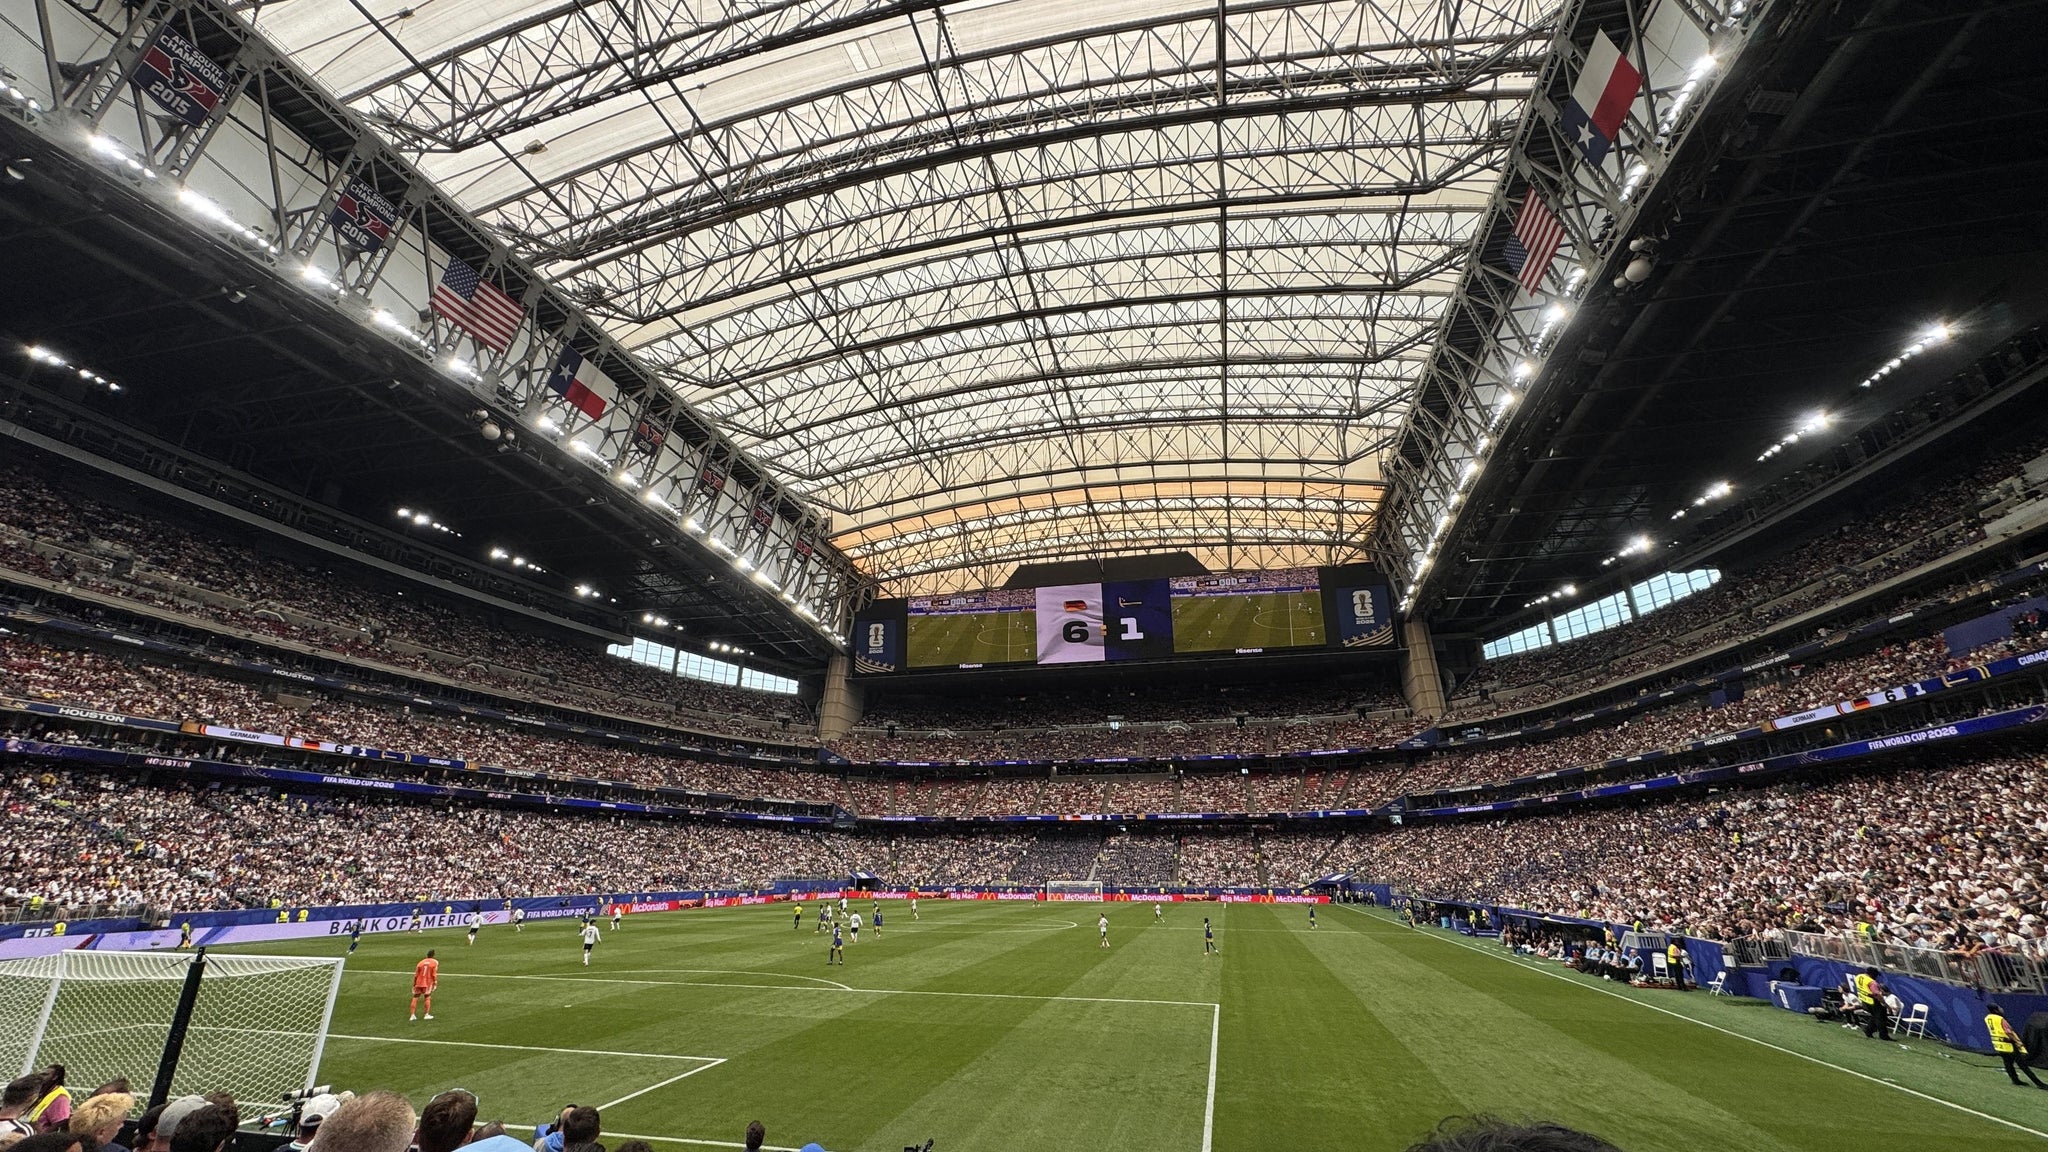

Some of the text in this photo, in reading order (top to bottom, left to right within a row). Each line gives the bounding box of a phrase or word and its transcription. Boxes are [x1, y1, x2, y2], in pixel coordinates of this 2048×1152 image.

[160, 34, 225, 89] CHAMPIONS
[172, 35, 223, 77] AFC SOUTH
[149, 81, 191, 115] 2015
[350, 184, 396, 222] CHAMPIONS
[358, 183, 395, 212] AFC SOUTH
[341, 221, 370, 246] 2016
[1062, 617, 1144, 643] 6 1
[272, 669, 315, 682] HOUSTON
[1885, 682, 1926, 702] 6 1
[58, 708, 126, 722] HOUSTON
[1792, 712, 1816, 723] GERMANY
[230, 730, 261, 740] GERMANY
[1704, 734, 1737, 746] HOUSTON
[1868, 726, 1958, 750] FIFA WORLD CUP 2026
[335, 744, 368, 756] 6 1
[145, 758, 192, 768] HOUSTON
[338, 778, 361, 786] WORLD
[705, 899, 713, 907] Big
[1220, 894, 1232, 902] Big
[1276, 894, 1318, 904] McDelivery
[631, 902, 669, 912] McDonald's
[526, 910, 540, 919] FIFA
[541, 909, 562, 918] WORLD
[386, 918, 408, 930] OF
[411, 914, 474, 930] MERIC
[24, 928, 54, 938] FIF
